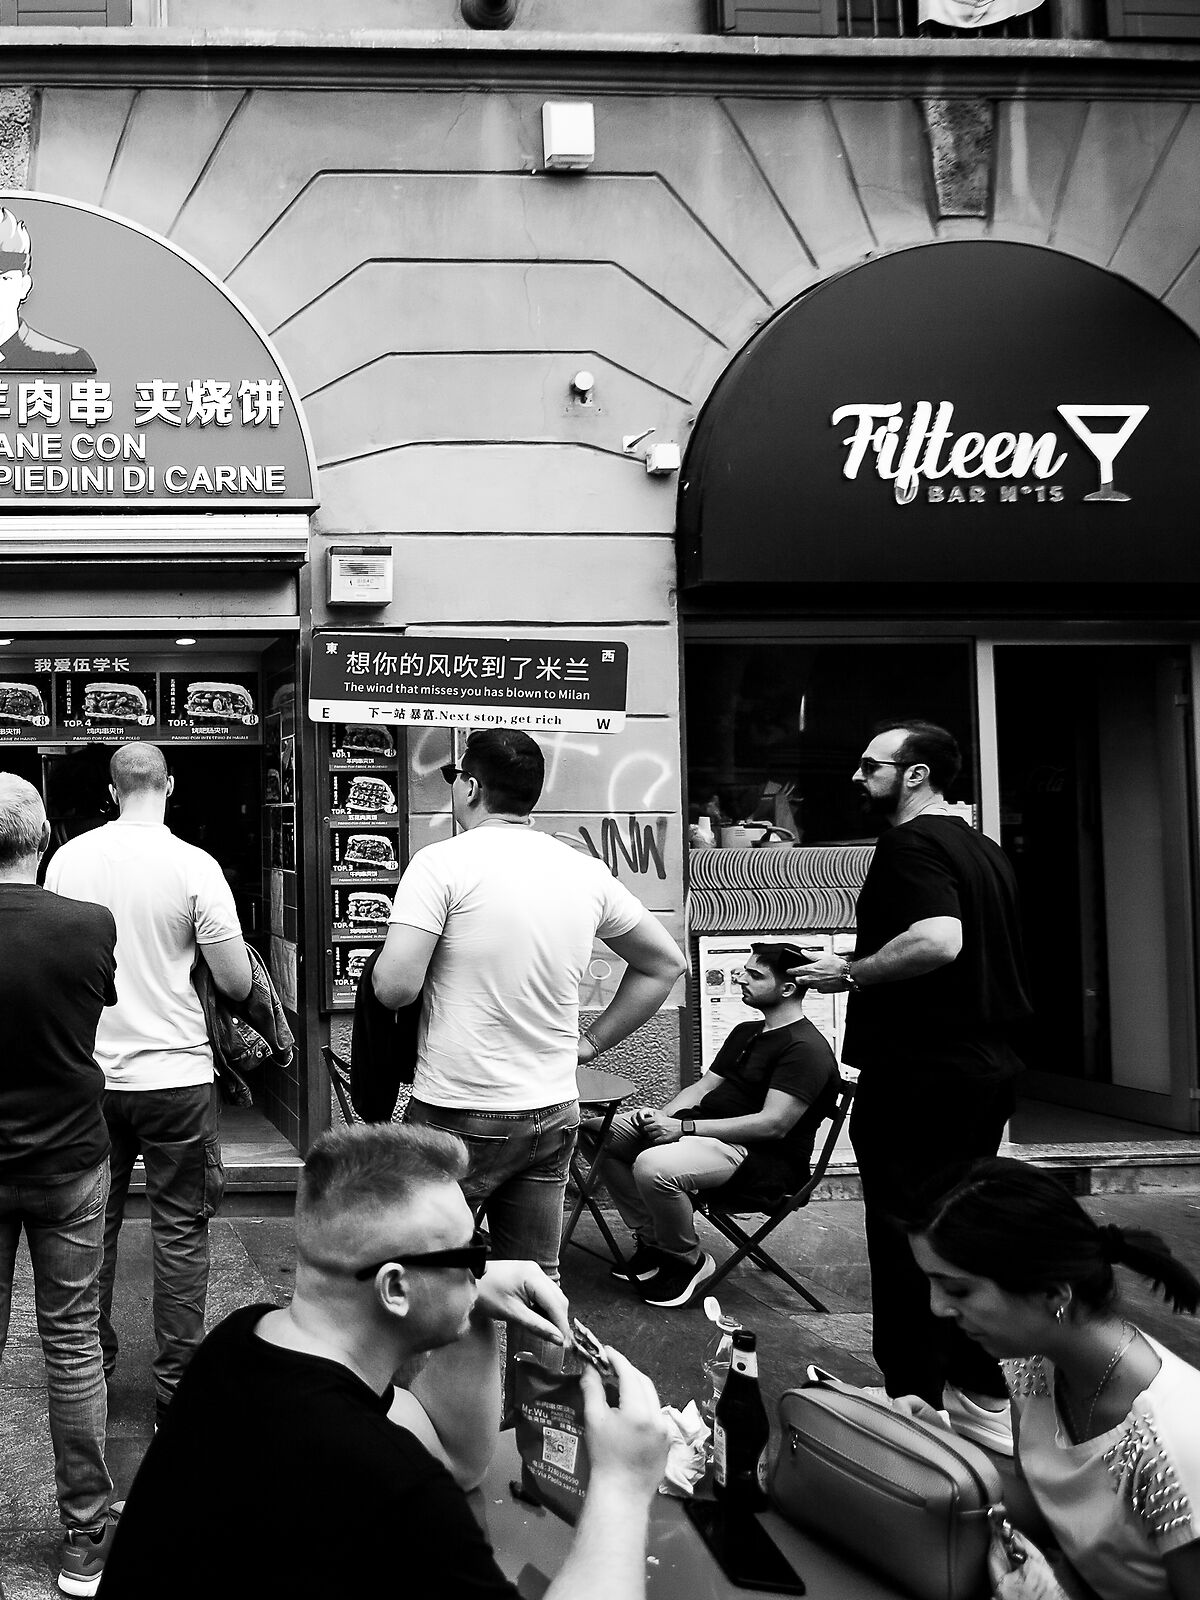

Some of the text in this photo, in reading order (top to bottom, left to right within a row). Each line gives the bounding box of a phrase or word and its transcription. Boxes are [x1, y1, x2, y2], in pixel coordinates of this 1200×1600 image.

[134, 378, 284, 428] 夹烧饼
[71, 433, 146, 462] CON
[832, 401, 1068, 504] Fifteen
[123, 465, 155, 494] DI
[164, 465, 286, 494] CARNE
[927, 485, 985, 502] BAR
[325, 642, 338, 655] 東
[601, 650, 615, 663] 西
[34, 658, 130, 672] 我爱伍学长
[346, 651, 590, 681] 想你的风吹到了米兰
[344, 682, 590, 700] The wind that misses you has blown to Milan
[322, 708, 330, 719] E
[369, 707, 406, 720] 下一站
[474, 713, 507, 724] stop,
[511, 715, 531, 725] get
[535, 716, 562, 725] rich
[597, 718, 611, 730] W
